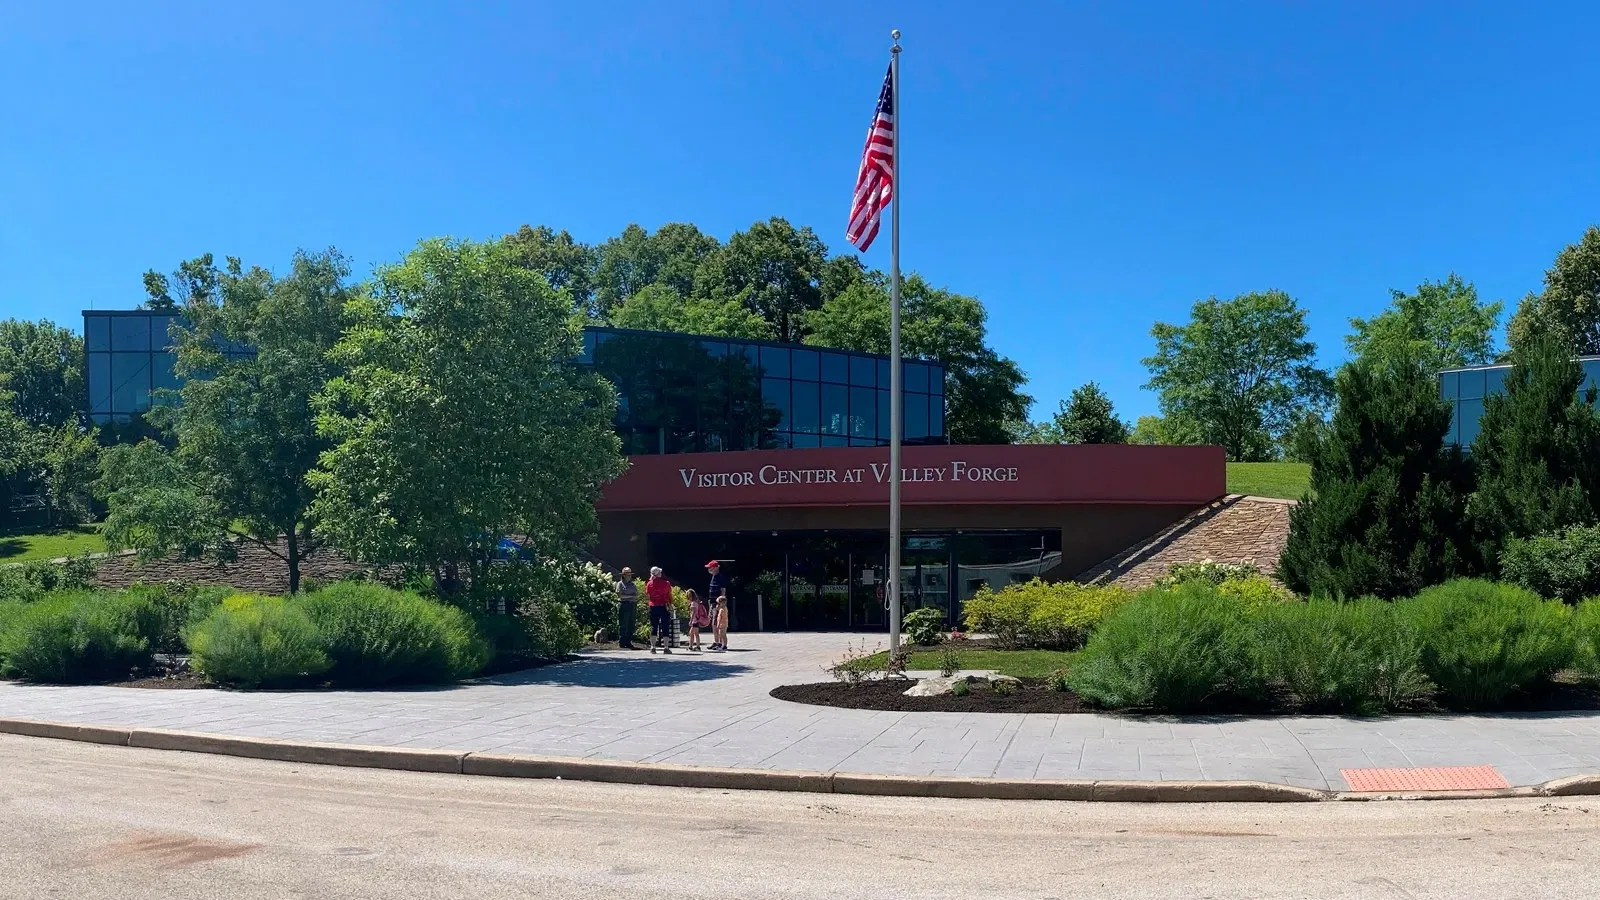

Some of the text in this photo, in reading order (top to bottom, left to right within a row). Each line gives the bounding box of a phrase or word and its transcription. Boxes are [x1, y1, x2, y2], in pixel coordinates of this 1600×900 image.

[679, 461, 1019, 488] VISITOR CENTER AT VLLEY FORGE
